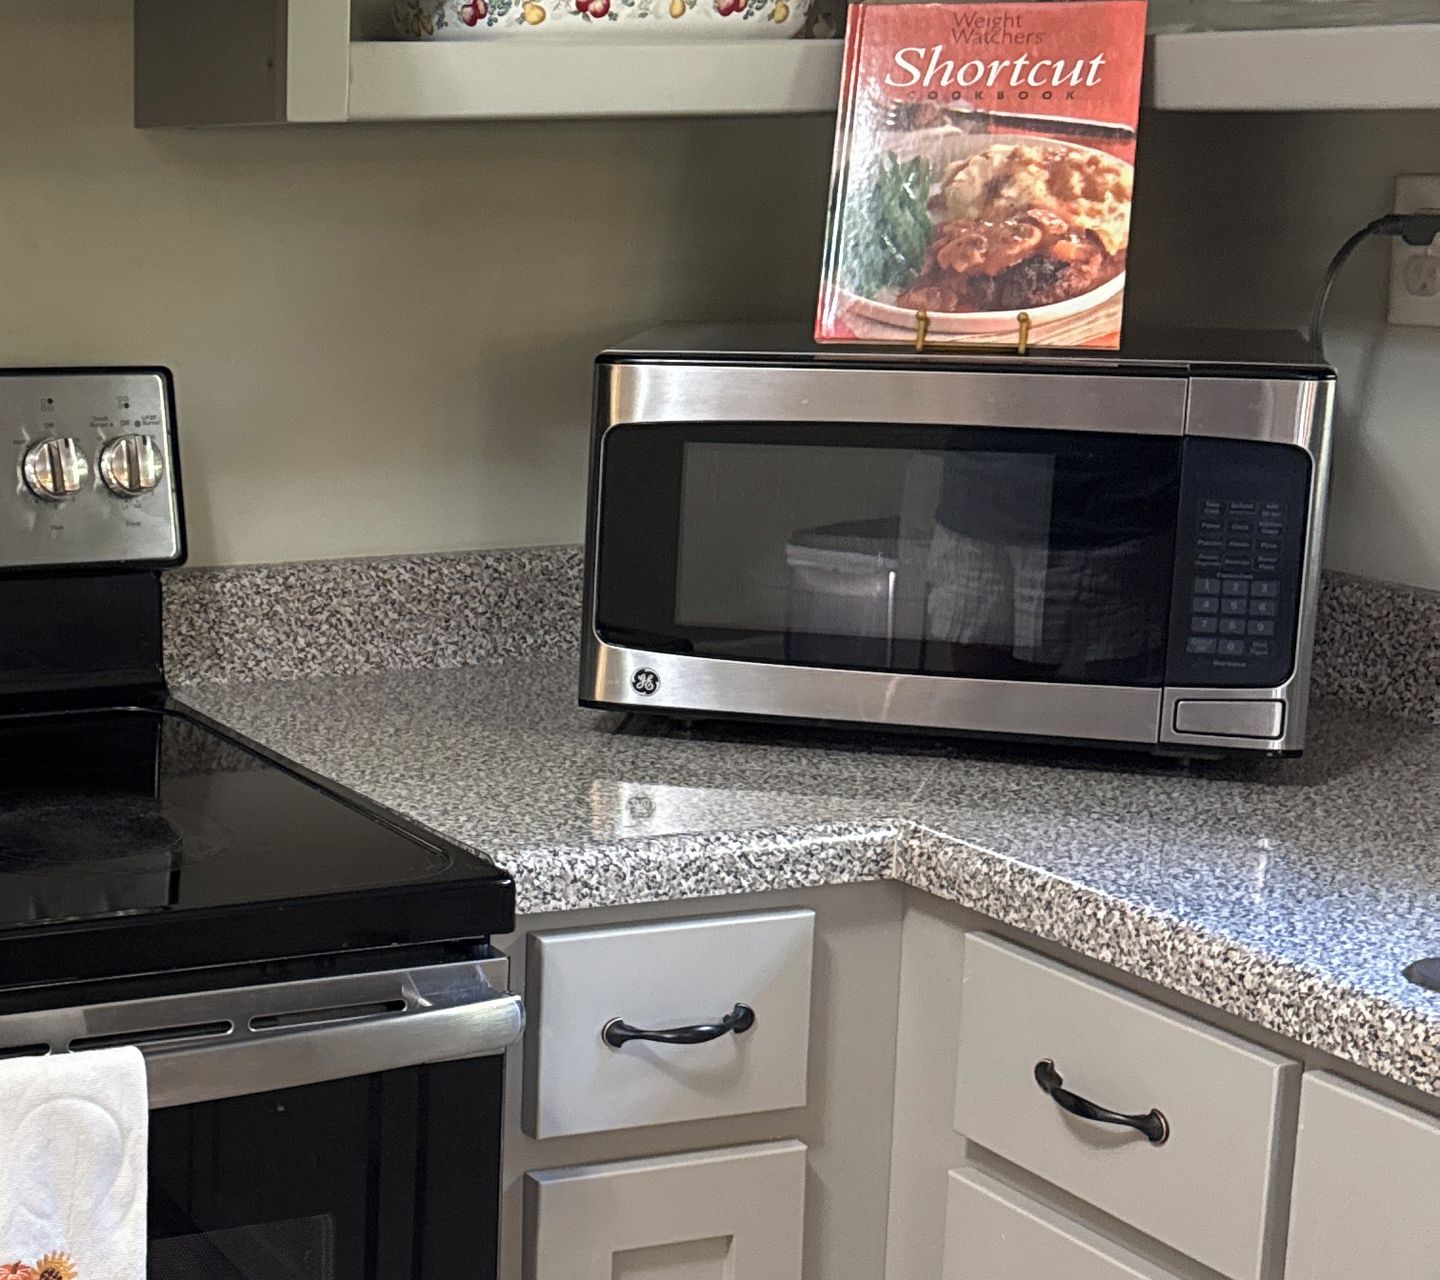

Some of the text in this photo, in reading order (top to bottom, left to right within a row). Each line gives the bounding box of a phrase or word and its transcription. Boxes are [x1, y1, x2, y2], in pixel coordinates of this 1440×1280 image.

[953, 11, 1023, 32] Weight
[951, 27, 1043, 46] Watchers
[884, 45, 1107, 88] Shortcut
[907, 90, 1077, 101] COOKBOOK
